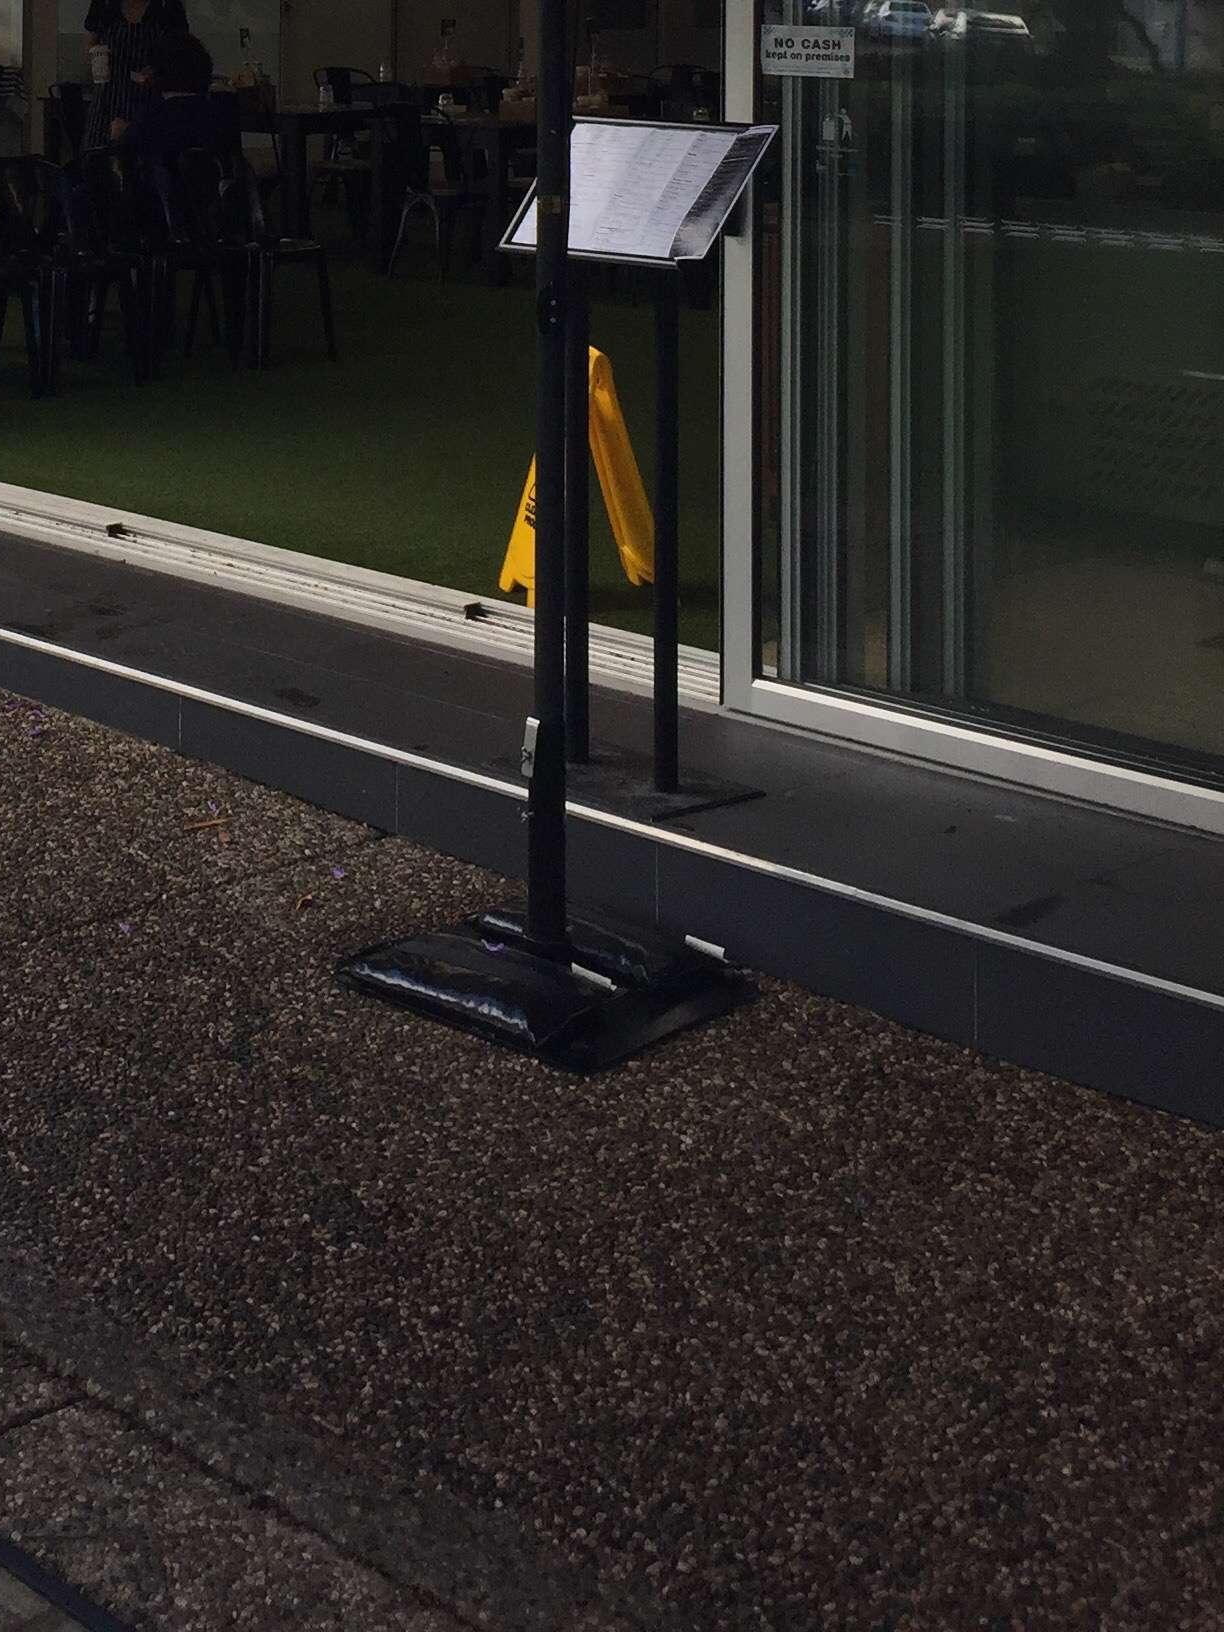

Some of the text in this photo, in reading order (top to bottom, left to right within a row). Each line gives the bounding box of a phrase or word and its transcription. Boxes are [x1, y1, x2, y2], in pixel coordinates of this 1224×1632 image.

[773, 37, 841, 50] NO CASH
[765, 49, 788, 61] kept
[790, 52, 803, 60] on
